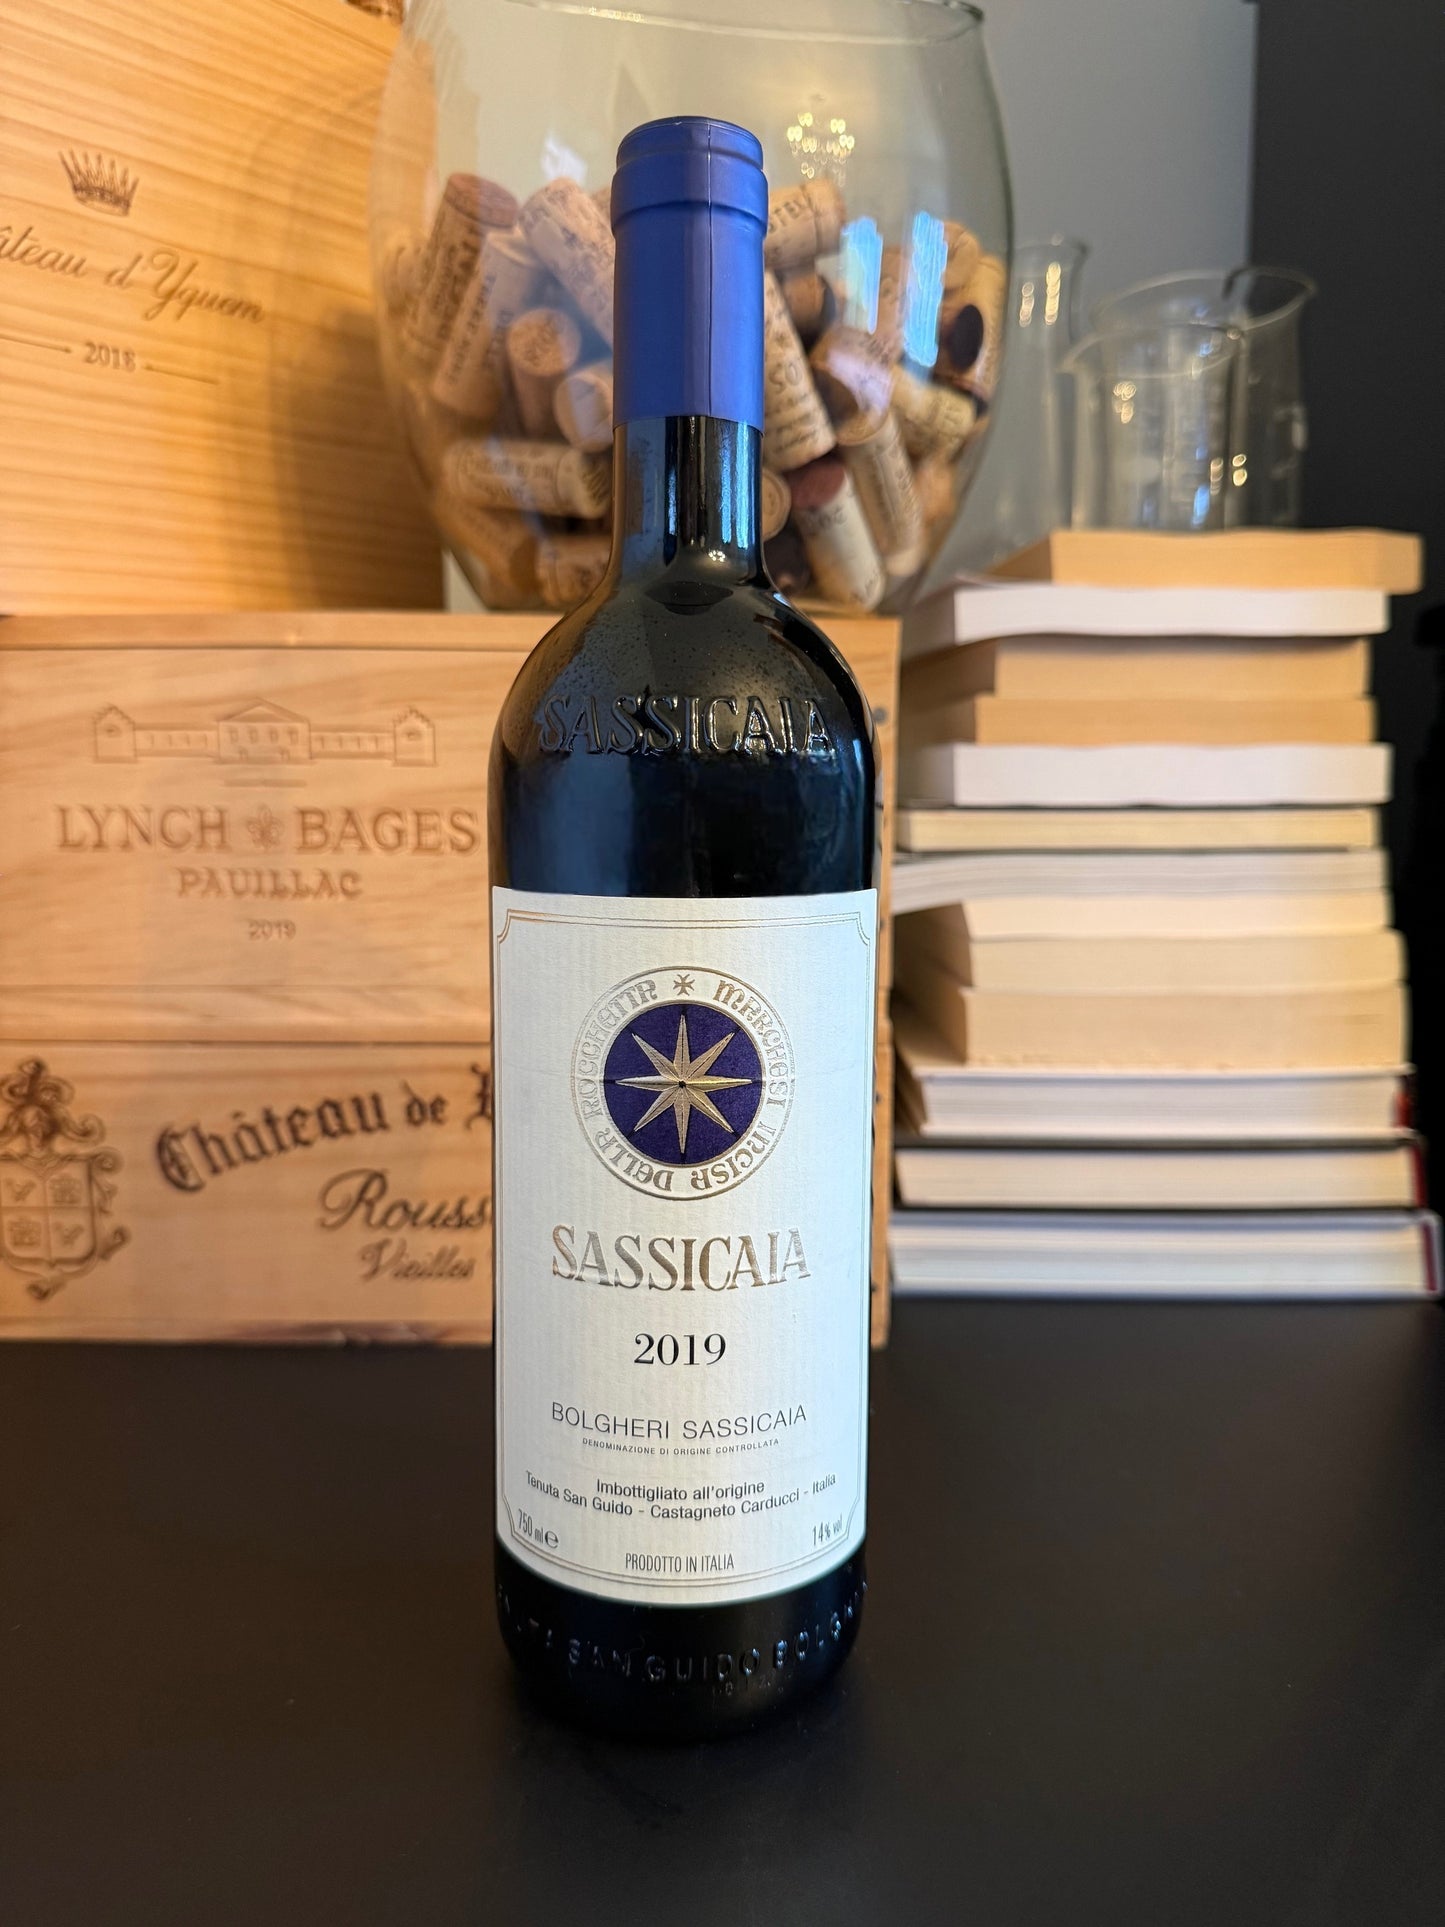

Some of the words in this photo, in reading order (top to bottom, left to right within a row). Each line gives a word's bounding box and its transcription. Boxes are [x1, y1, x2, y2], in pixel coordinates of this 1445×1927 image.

[84, 341, 137, 372] 2018
[539, 695, 833, 755] SASSICAIA
[57, 804, 231, 852] LYNCH
[293, 806, 480, 857] BAGES
[177, 866, 363, 900] PAUILLAC
[247, 919, 296, 941] 2019
[154, 1091, 391, 1193] Château
[401, 1078, 447, 1127] de
[552, 1223, 812, 1292] SASSICAIA
[633, 1332, 727, 1366] 2019
[551, 1401, 669, 1440] BOLGHERI
[683, 1404, 807, 1440] SASSICAIA
[582, 1436, 656, 1456] DENOMINAZIONE
[659, 1446, 670, 1456] DI
[673, 1446, 712, 1456] ORIGINE
[716, 1437, 780, 1455] CONTROLLATA
[525, 1469, 560, 1500] Tenuta
[563, 1488, 588, 1508] San
[592, 1497, 634, 1517] Guido
[650, 1503, 736, 1521] Castagneto
[741, 1487, 800, 1515] Carducci
[812, 1473, 836, 1495] Italia
[596, 1478, 688, 1502] Imbottigliato
[693, 1480, 766, 1501] all'origine
[518, 1508, 533, 1538] 750
[812, 1521, 831, 1547] 14%
[625, 1552, 682, 1573] PRODOTTO
[685, 1554, 698, 1573] IN
[701, 1553, 735, 1572] ITALIA
